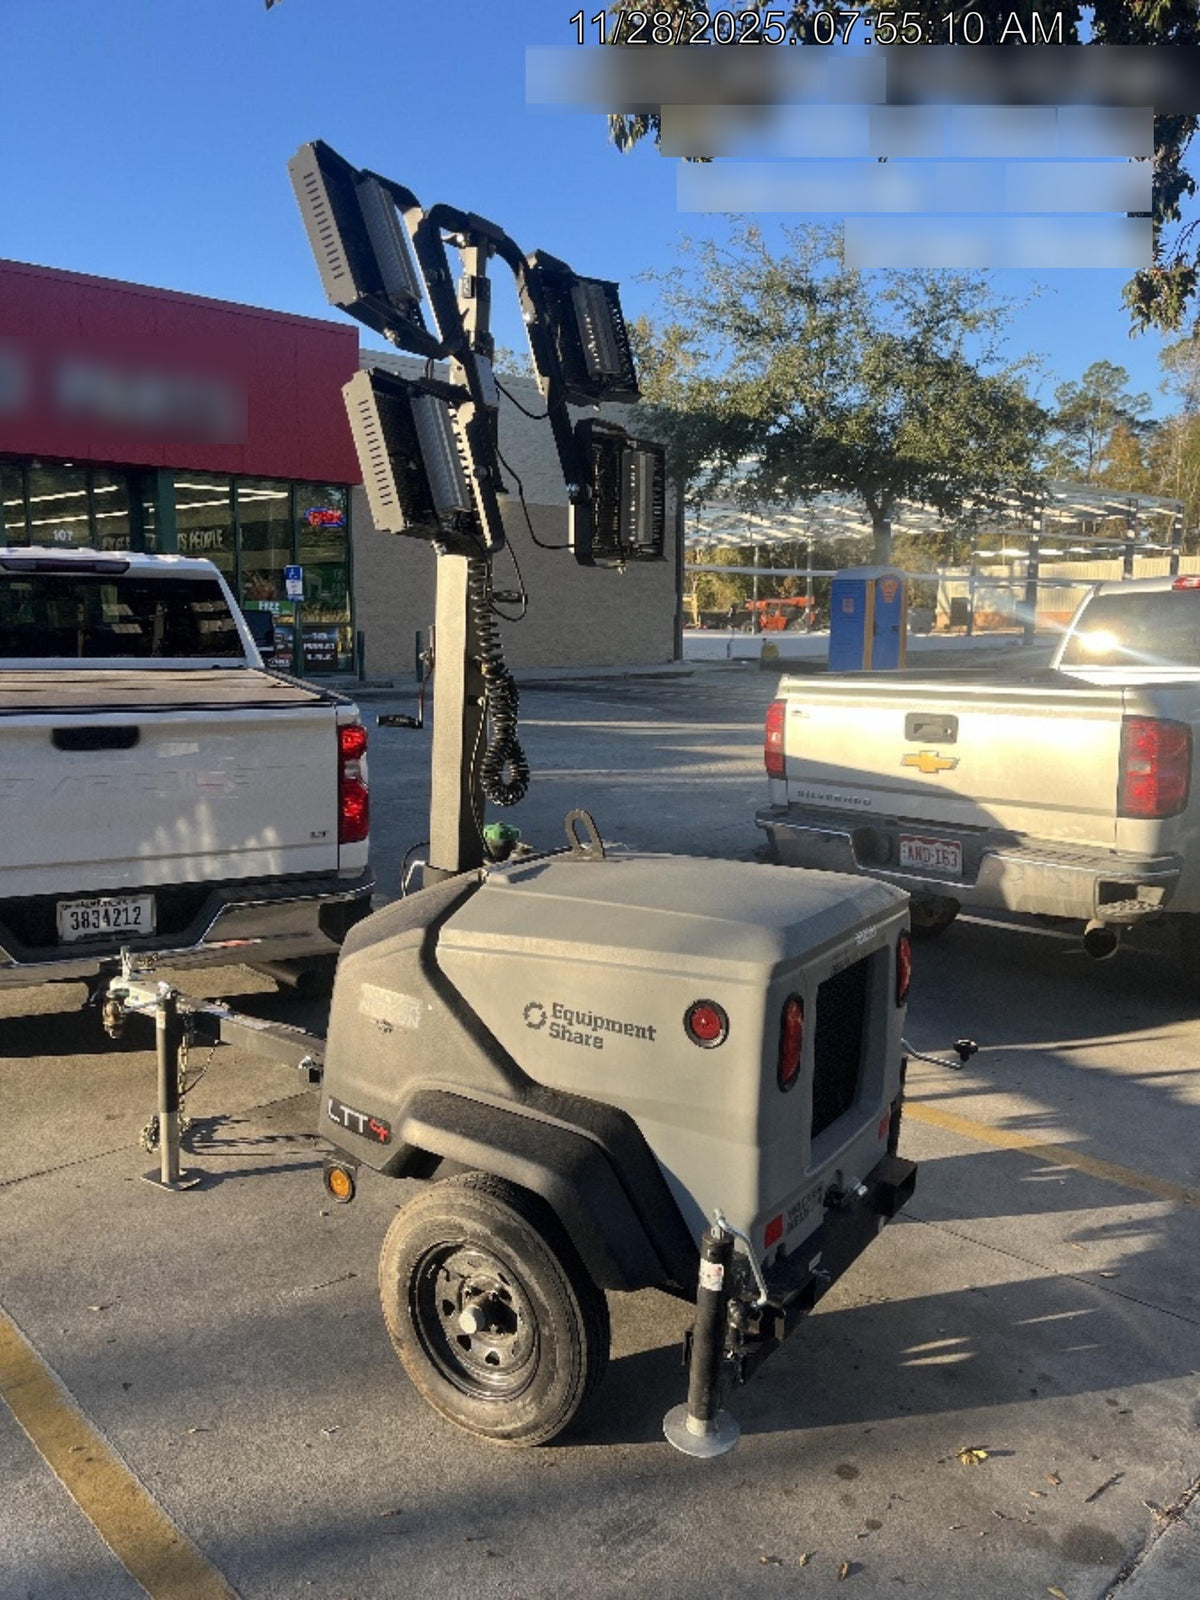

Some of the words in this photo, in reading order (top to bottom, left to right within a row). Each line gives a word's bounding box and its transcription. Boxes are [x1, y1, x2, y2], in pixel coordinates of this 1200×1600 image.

[53, 529, 73, 541] 107
[189, 529, 224, 549] PEOPLE
[258, 601, 280, 611] FREE
[70, 906, 142, 931] 3834212
[551, 1002, 657, 1042] Equipment
[549, 1022, 604, 1050] Share
[328, 1098, 390, 1143] LTT4
